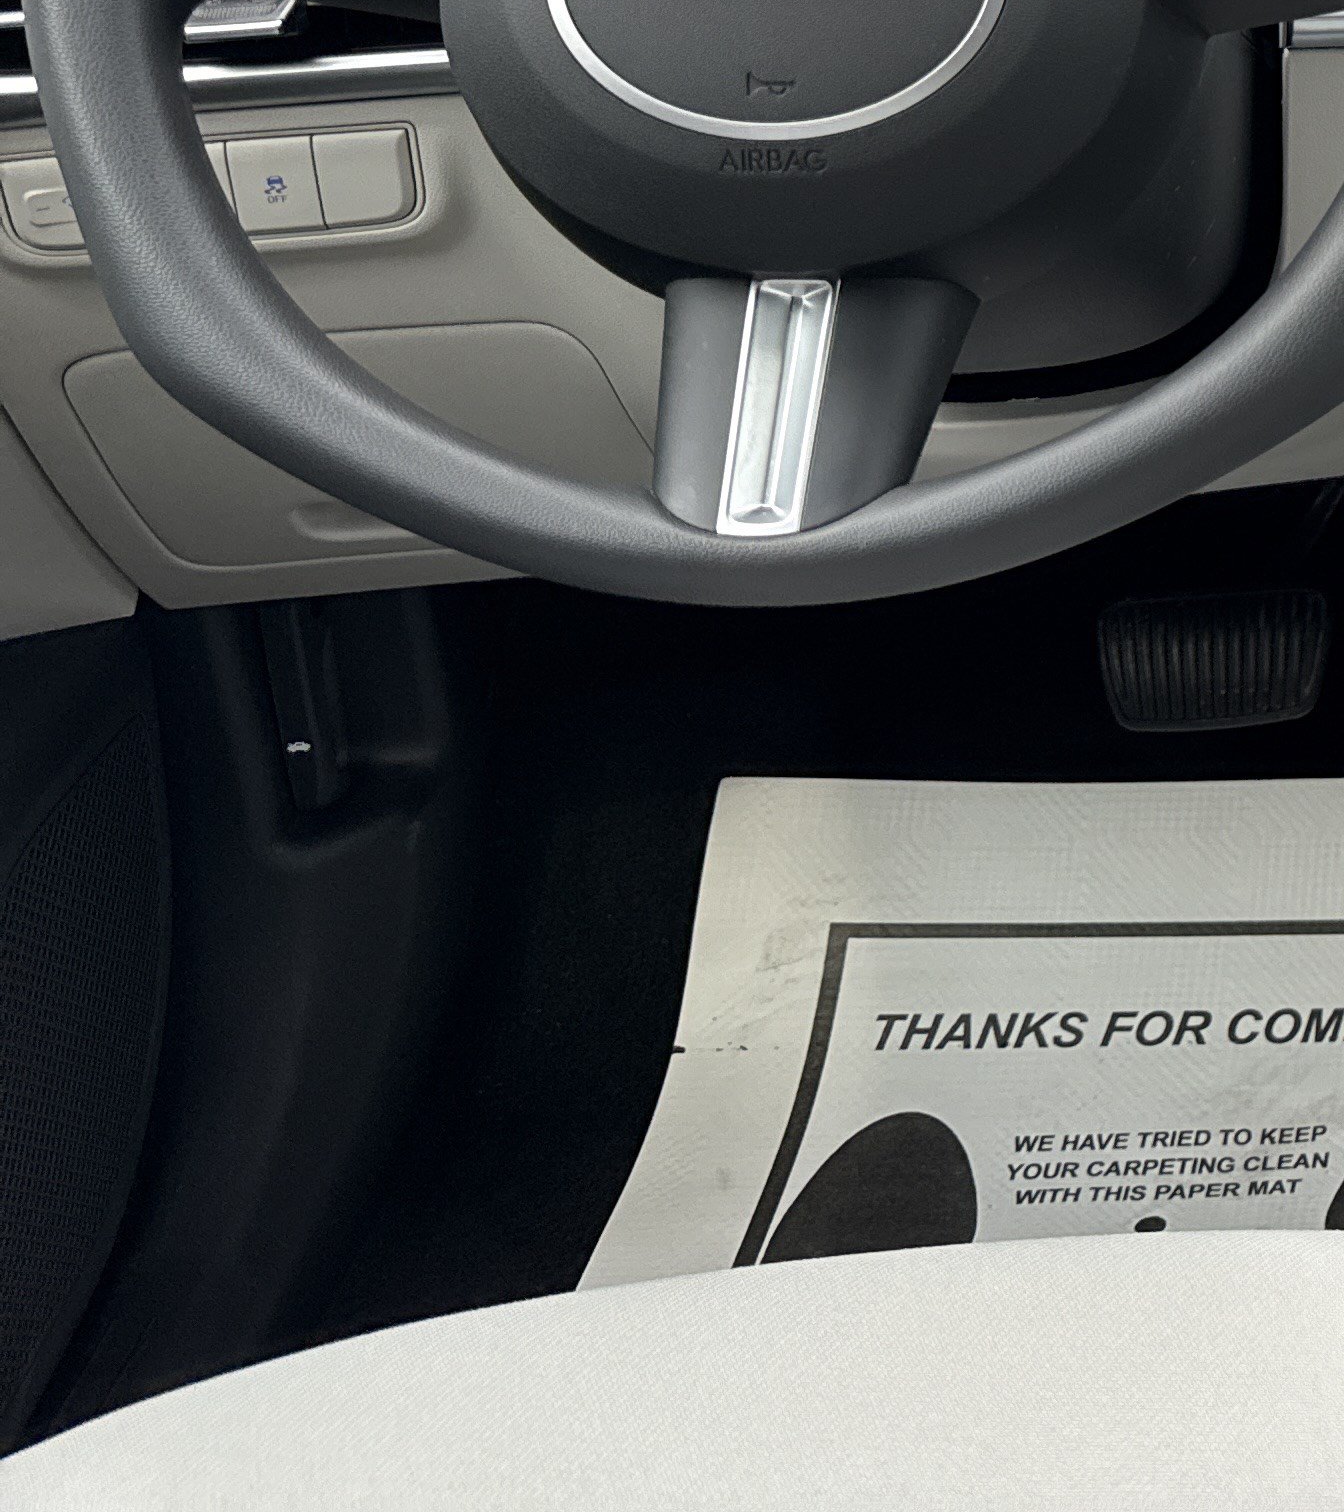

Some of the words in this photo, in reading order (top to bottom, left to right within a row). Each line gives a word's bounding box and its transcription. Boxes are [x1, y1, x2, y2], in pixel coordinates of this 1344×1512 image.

[718, 147, 828, 174] AIRBAG
[267, 194, 287, 204] OFF
[873, 1010, 1089, 1051] THANKS
[1100, 1009, 1211, 1048] FOR
[1014, 1134, 1056, 1153] WE
[1060, 1132, 1130, 1151] HAVE
[1137, 1129, 1211, 1149] TRIED
[1219, 1127, 1253, 1147] TO
[1259, 1125, 1327, 1145] KEEP
[1007, 1161, 1079, 1180] YOUR
[1086, 1157, 1235, 1177] CARPETING
[1243, 1151, 1331, 1172] CLEAN
[1015, 1187, 1082, 1205] WITH
[1088, 1184, 1147, 1203] THIS
[1153, 1181, 1241, 1200] PAPER
[1247, 1178, 1302, 1197] MAT
